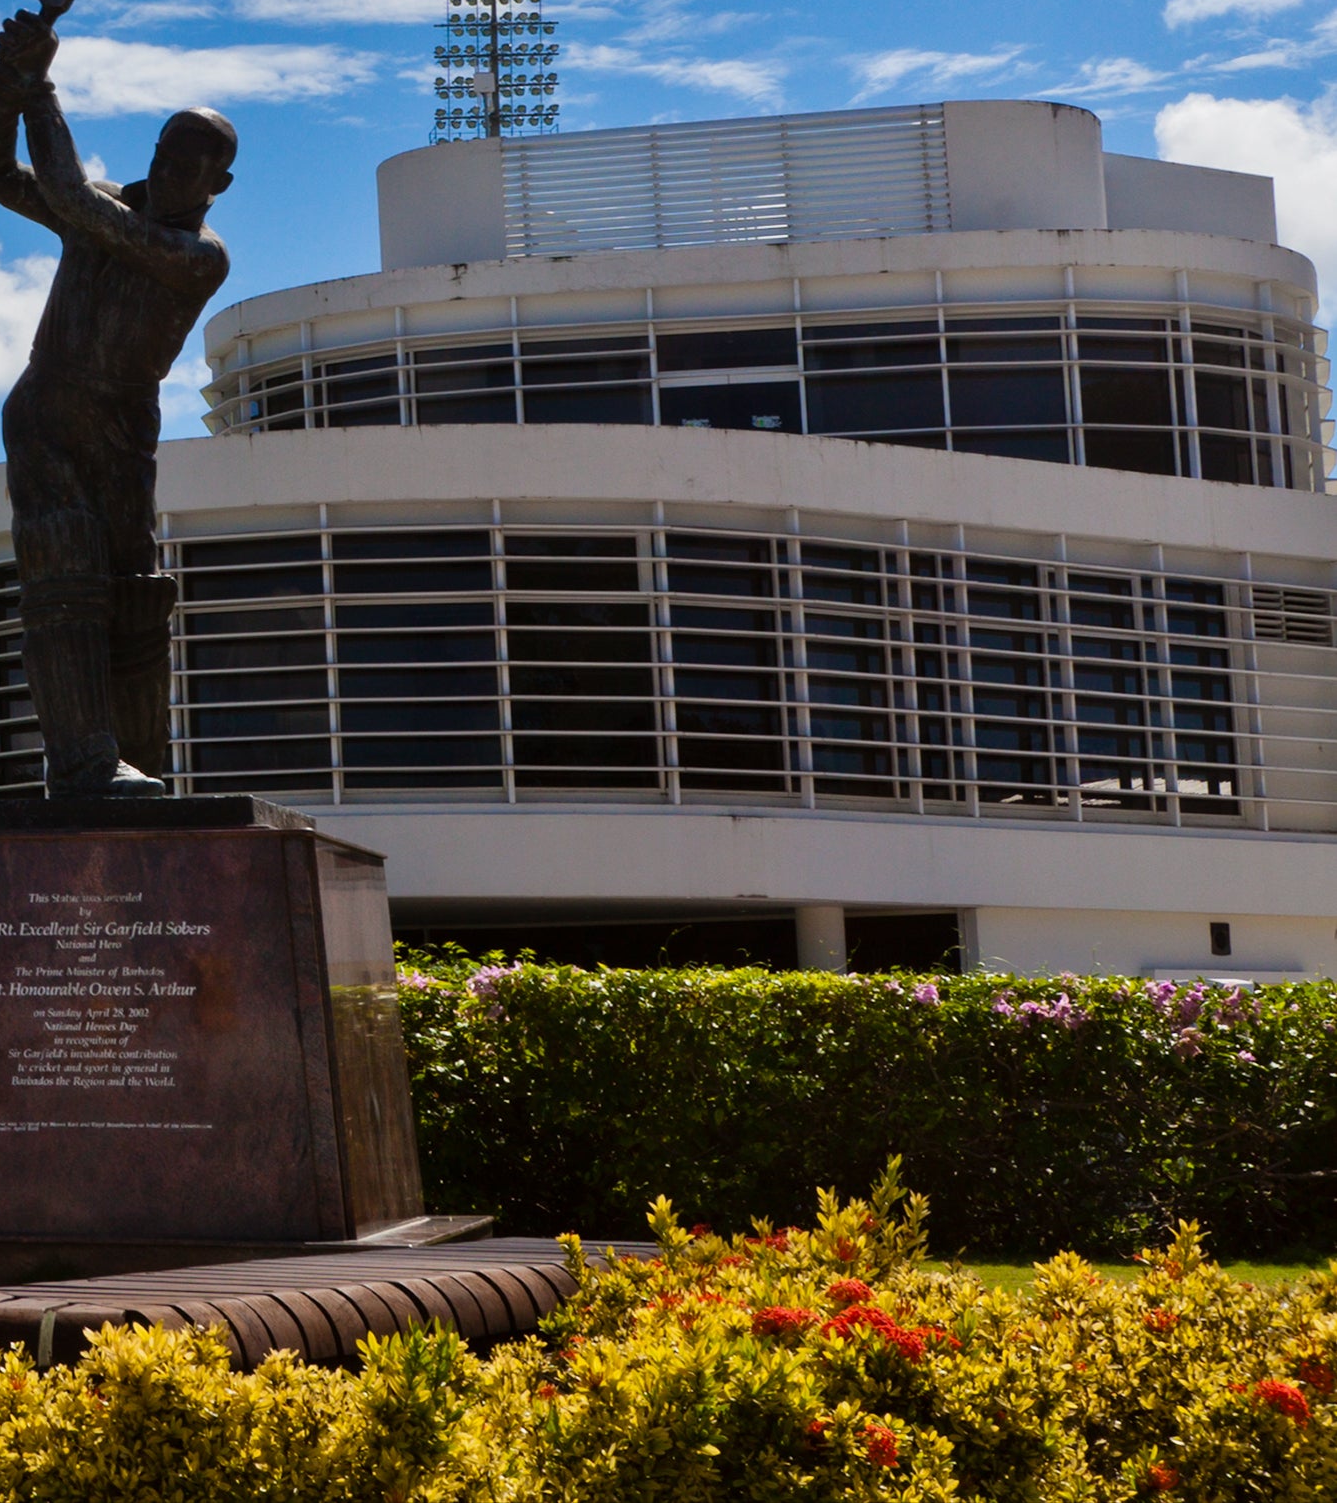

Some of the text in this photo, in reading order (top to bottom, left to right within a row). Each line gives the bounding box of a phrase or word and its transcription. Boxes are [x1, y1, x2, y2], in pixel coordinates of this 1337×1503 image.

[29, 893, 49, 902] This
[79, 907, 91, 917] by
[20, 922, 80, 936] Excellent
[83, 922, 102, 935] Sir
[105, 921, 162, 939] Garfield
[166, 921, 211, 935] Sobers
[56, 940, 122, 949] National Hero
[79, 953, 96, 962] and
[15, 967, 165, 978] The Prime Minister of Barbados
[9, 982, 87, 996] Honourable
[89, 982, 131, 996] Owen
[148, 982, 196, 996] Arthur
[48, 1008, 81, 1018] Sunday
[87, 1008, 109, 1019] April
[129, 1008, 149, 1017] 2002
[43, 1022, 138, 1033] National Heroes Day
[119, 1036, 129, 1047] of
[8, 1049, 23, 1058] Sir
[119, 1049, 177, 1059] contribution
[29, 1062, 60, 1072] cricket
[64, 1063, 81, 1072] and
[85, 1064, 108, 1075] sport
[112, 1064, 121, 1072] in
[124, 1063, 158, 1075] general
[161, 1064, 170, 1072] in
[11, 1076, 54, 1086] Barbados
[56, 1076, 70, 1085] the
[73, 1077, 105, 1089] Region
[107, 1077, 125, 1086] and
[128, 1077, 142, 1086] the
